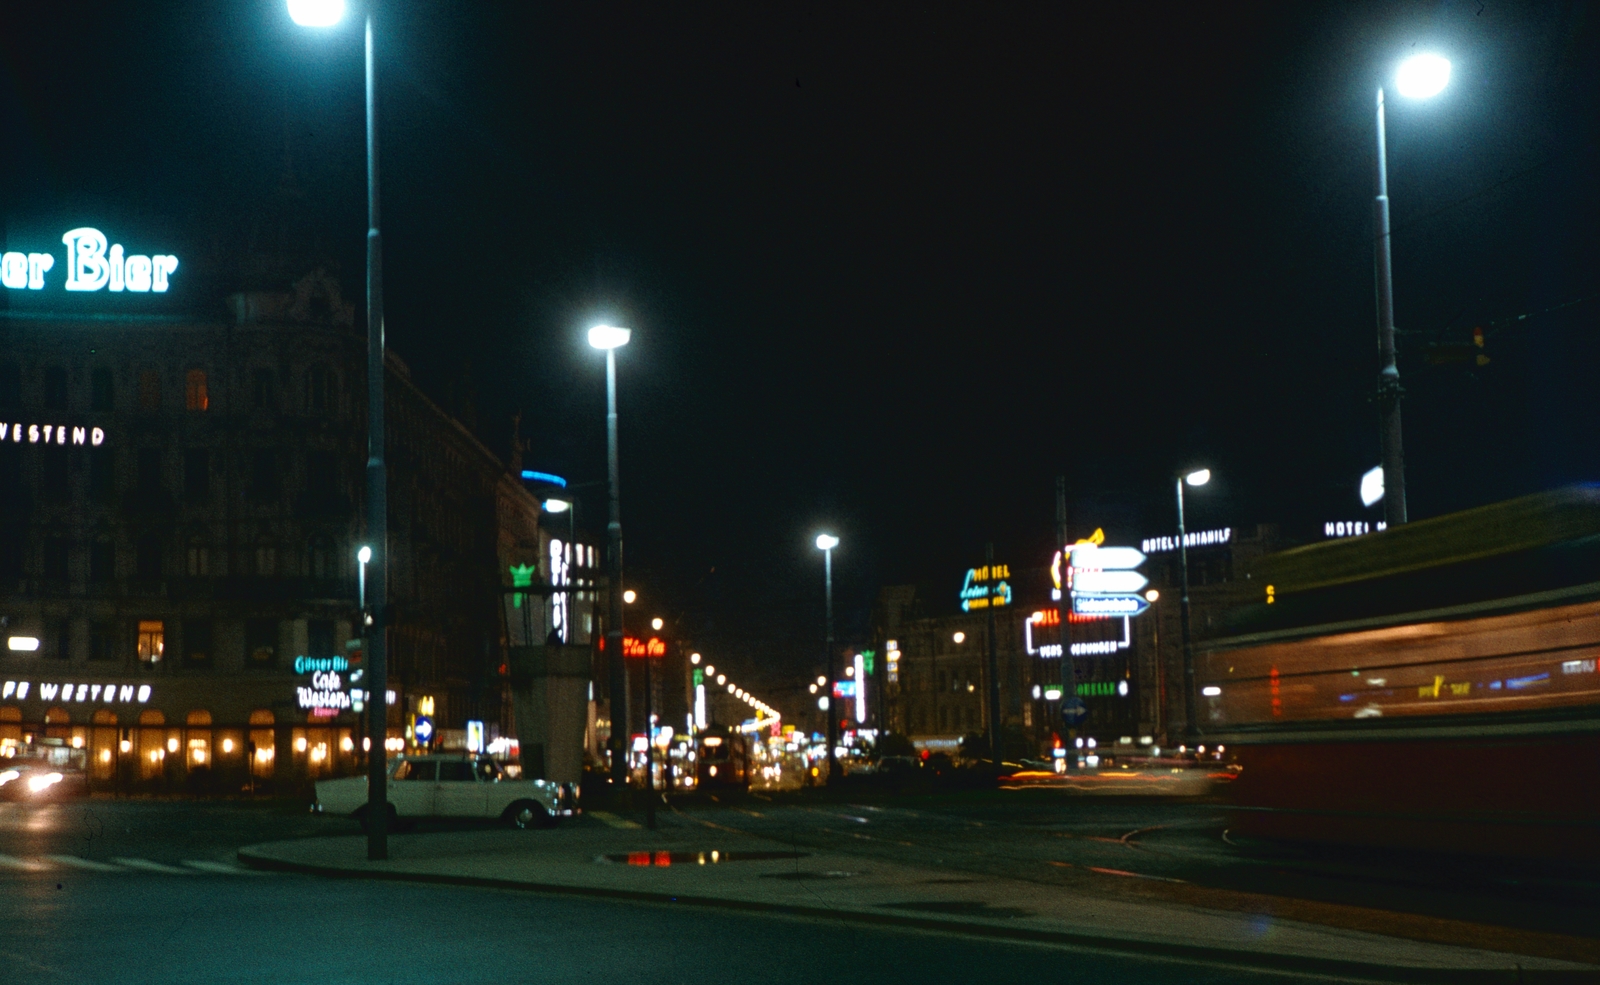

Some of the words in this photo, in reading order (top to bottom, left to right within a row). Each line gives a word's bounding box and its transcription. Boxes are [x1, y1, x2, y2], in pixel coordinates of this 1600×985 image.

[62, 227, 179, 292] Bier
[1142, 536, 1173, 553] HOTEL
[40, 681, 152, 703] WESTEND
